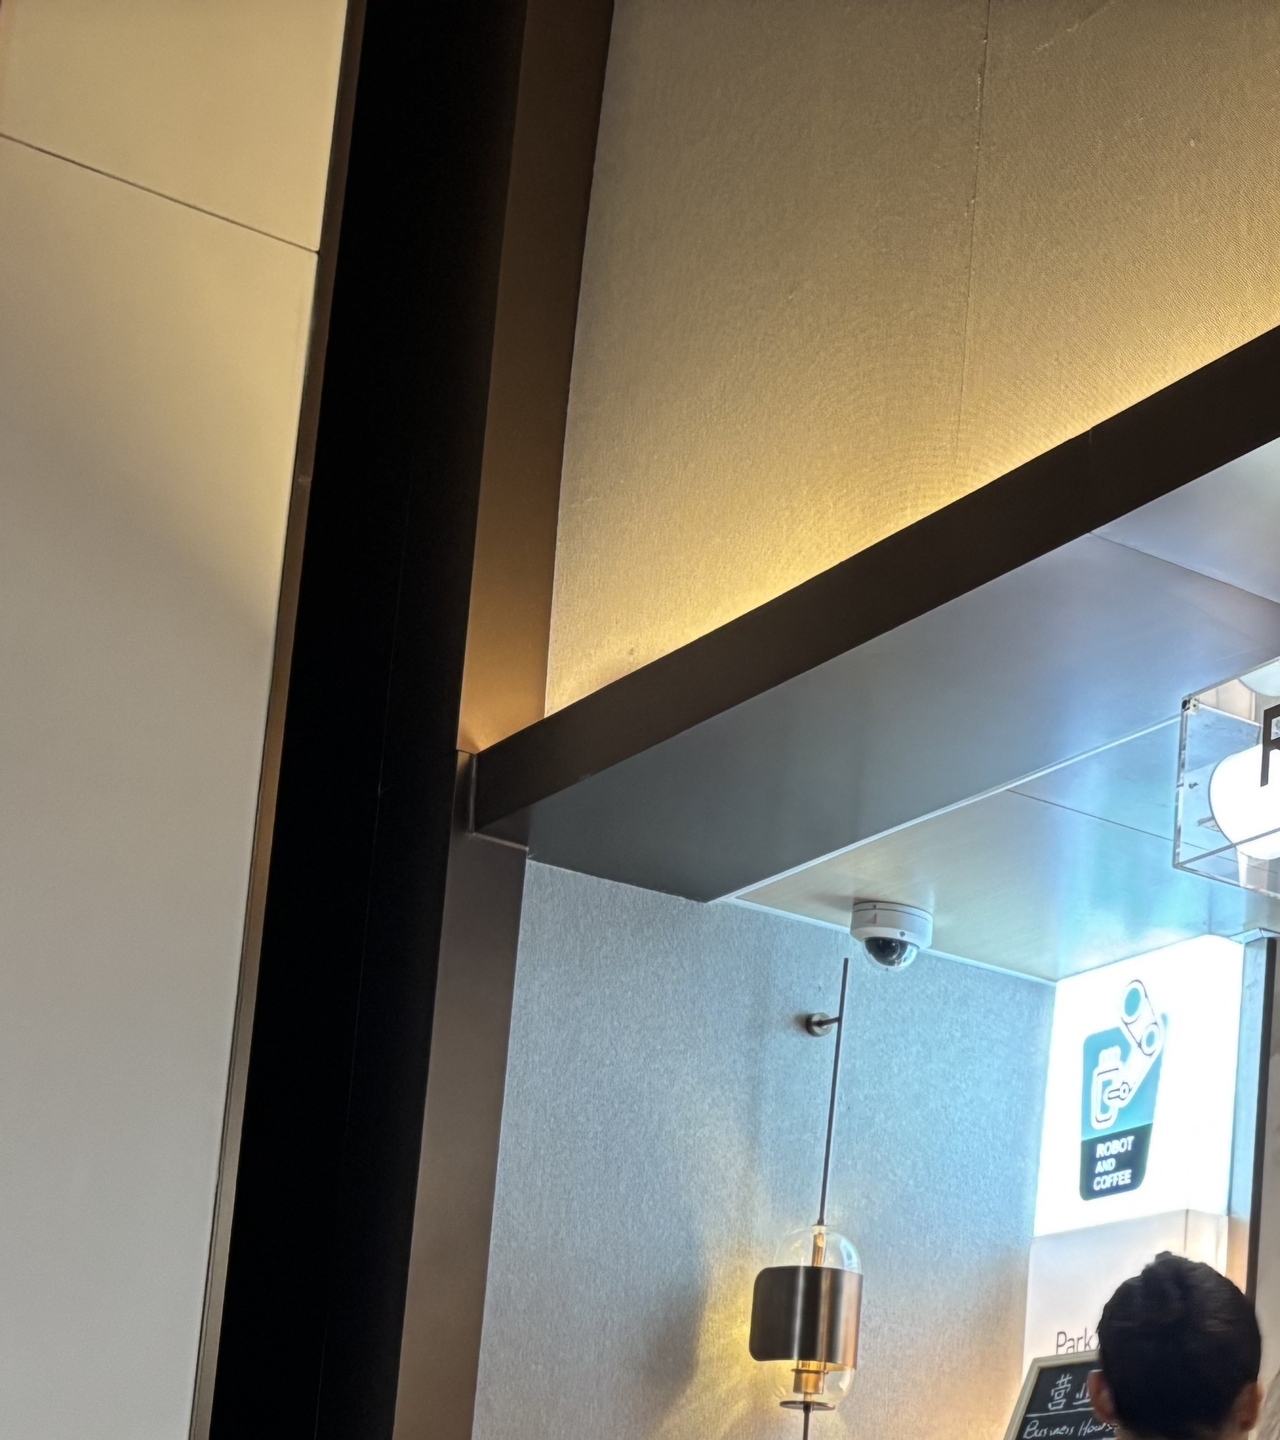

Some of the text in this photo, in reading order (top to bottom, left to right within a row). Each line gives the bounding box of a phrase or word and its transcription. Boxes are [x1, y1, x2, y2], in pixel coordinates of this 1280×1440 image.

[1095, 1135, 1135, 1158] ROBOT
[1095, 1157, 1116, 1174] AND
[1093, 1169, 1132, 1191] COFFEE
[1023, 1419, 1075, 1439] Business
